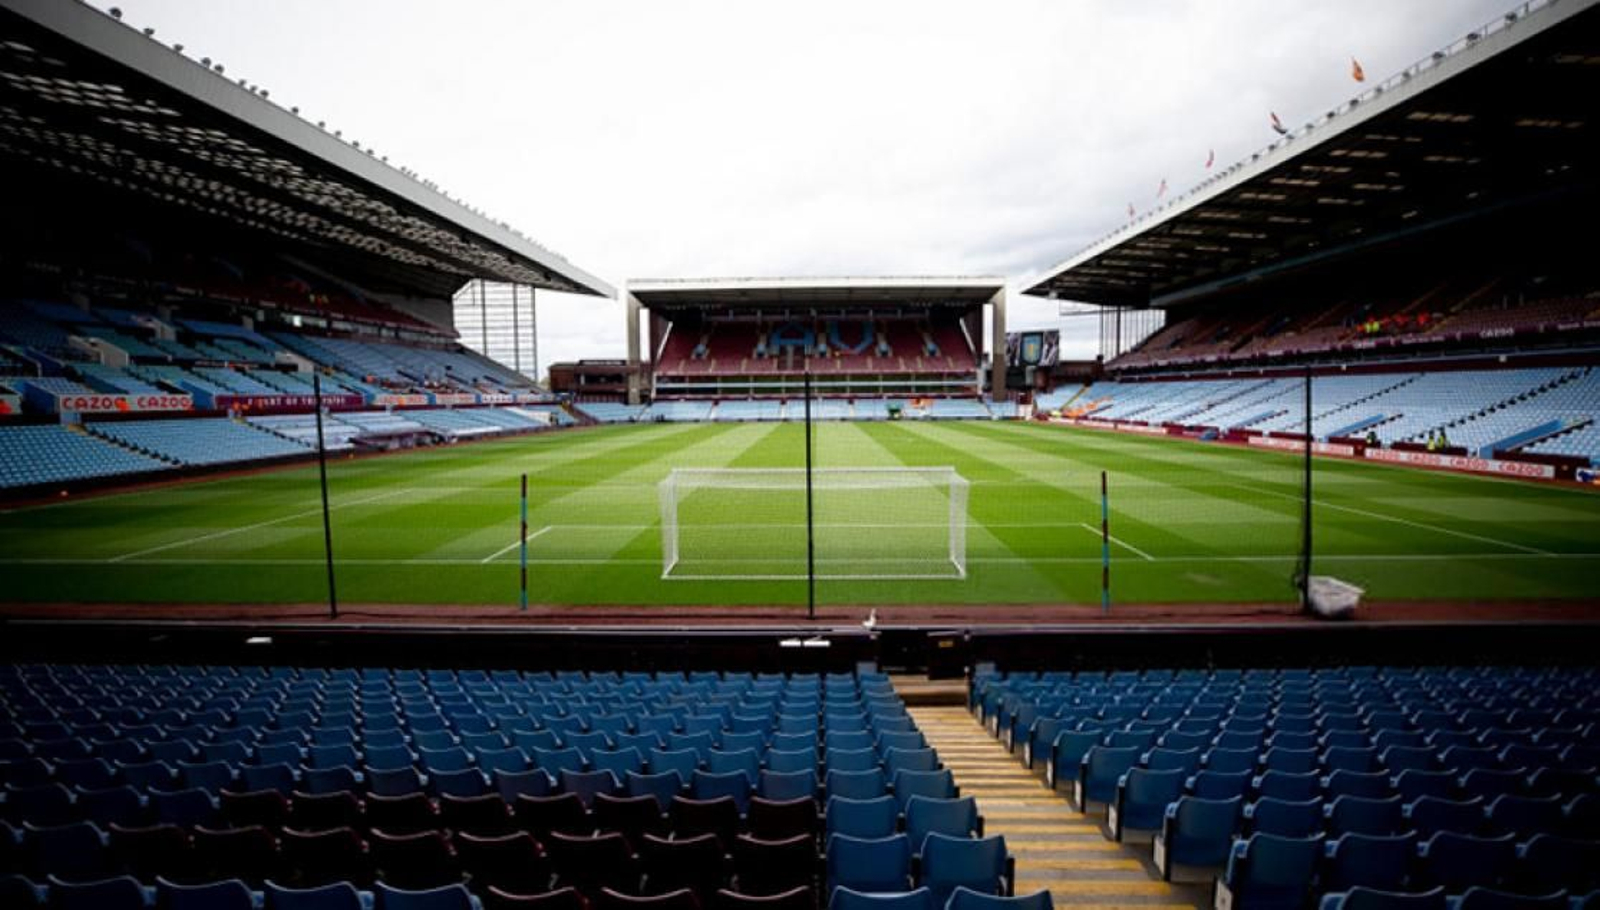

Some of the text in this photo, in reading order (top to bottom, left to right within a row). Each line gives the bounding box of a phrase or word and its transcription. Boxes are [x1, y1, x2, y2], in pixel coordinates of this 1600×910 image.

[1478, 327, 1514, 339] CAZOO
[63, 395, 191, 409] CAZOO CAZOO
[1451, 457, 1490, 470] CAZOO
[1499, 461, 1544, 476] CAZOO
